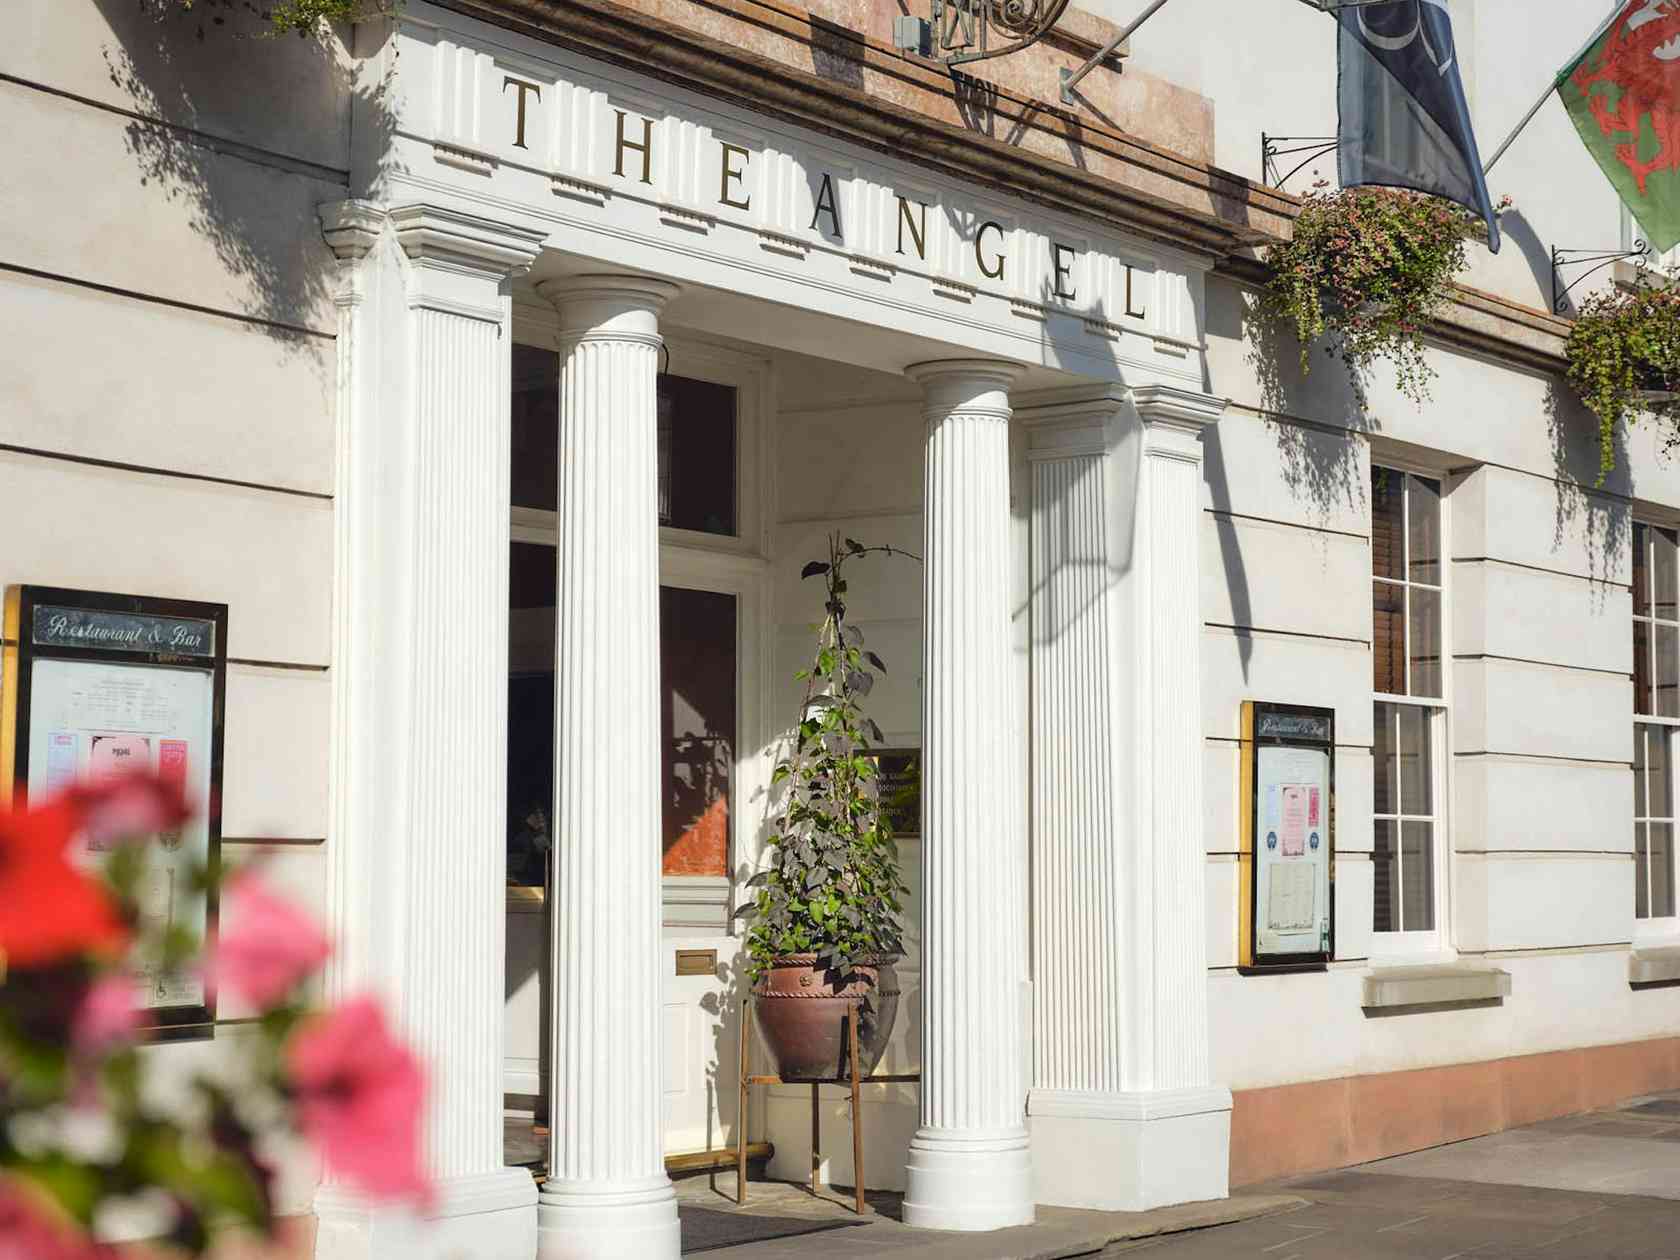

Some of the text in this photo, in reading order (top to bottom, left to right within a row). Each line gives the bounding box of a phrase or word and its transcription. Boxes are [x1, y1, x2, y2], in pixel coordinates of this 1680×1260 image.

[502, 75, 1145, 320] THE ANGEL
[48, 615, 202, 648] Restaurant & Bar
